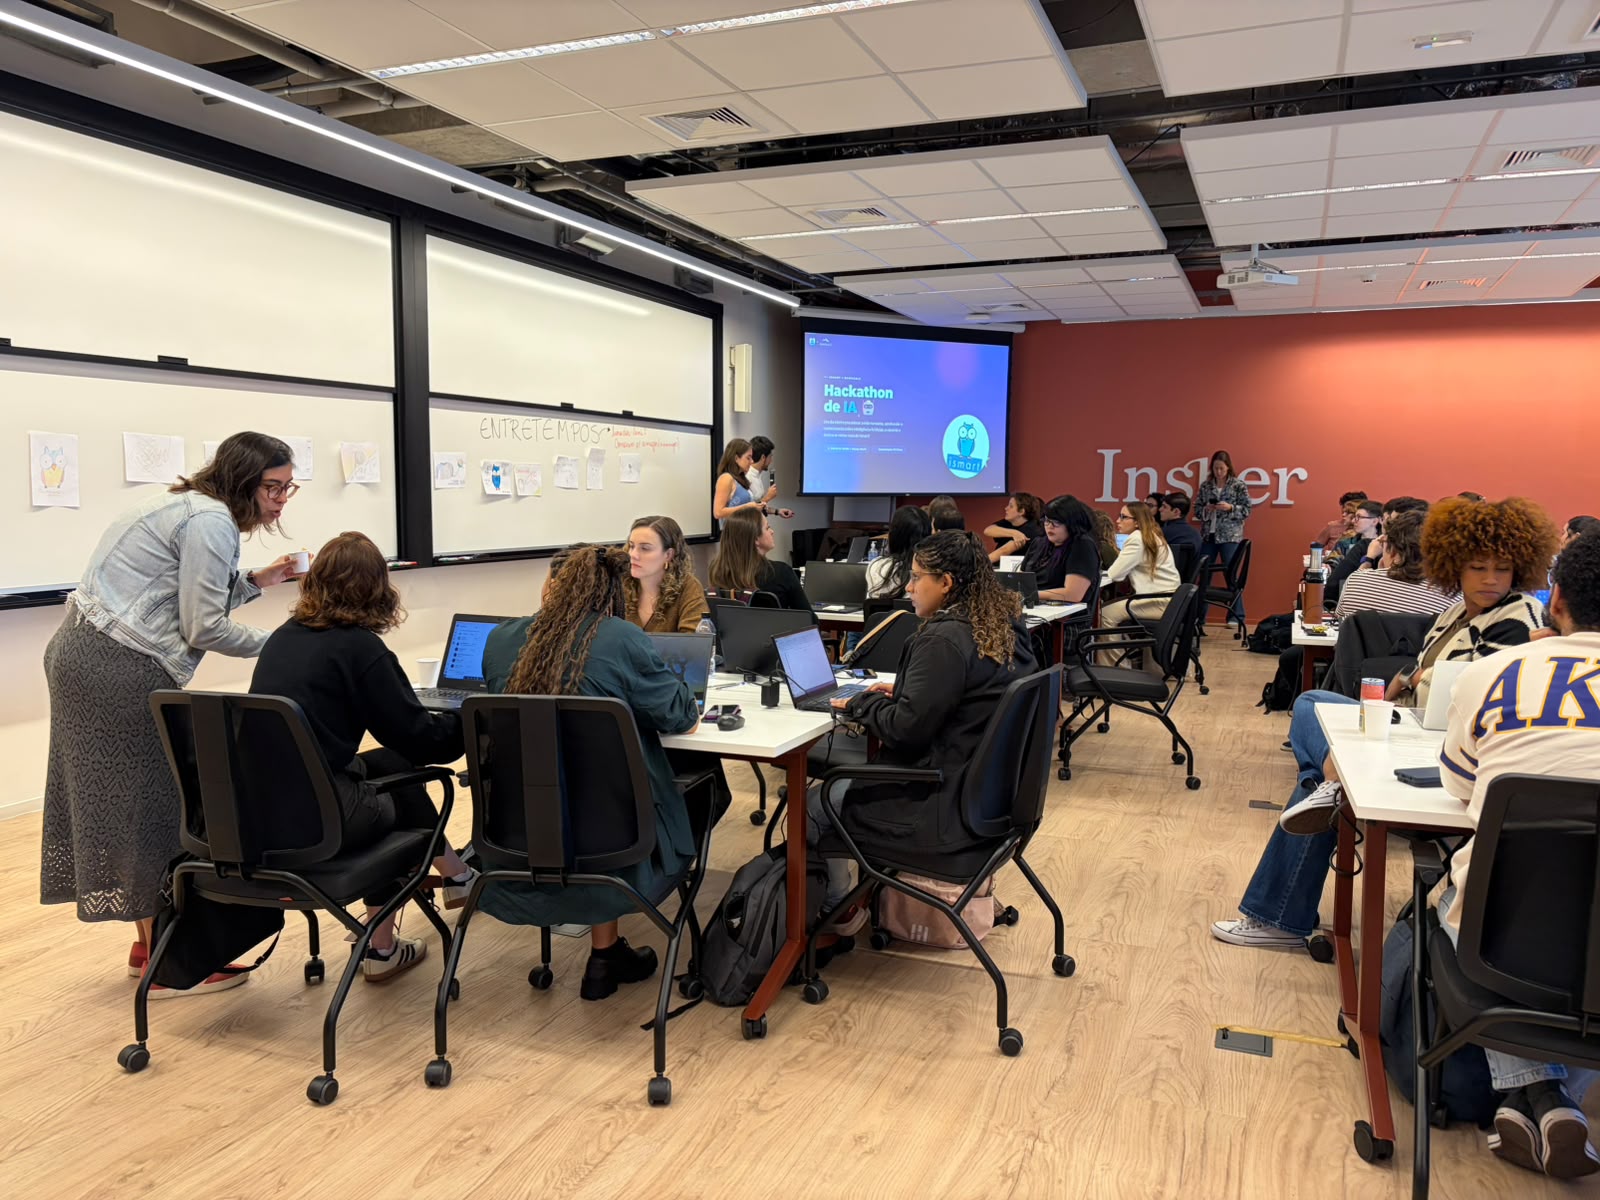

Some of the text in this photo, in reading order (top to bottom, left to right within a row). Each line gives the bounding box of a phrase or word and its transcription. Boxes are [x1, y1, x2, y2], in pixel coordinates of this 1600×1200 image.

[824, 384, 894, 399] Hackathon
[824, 399, 858, 414] de IA
[479, 416, 602, 444] ENTRETEMPOS
[948, 455, 982, 472] ismart
[1094, 448, 1309, 522] Inser
